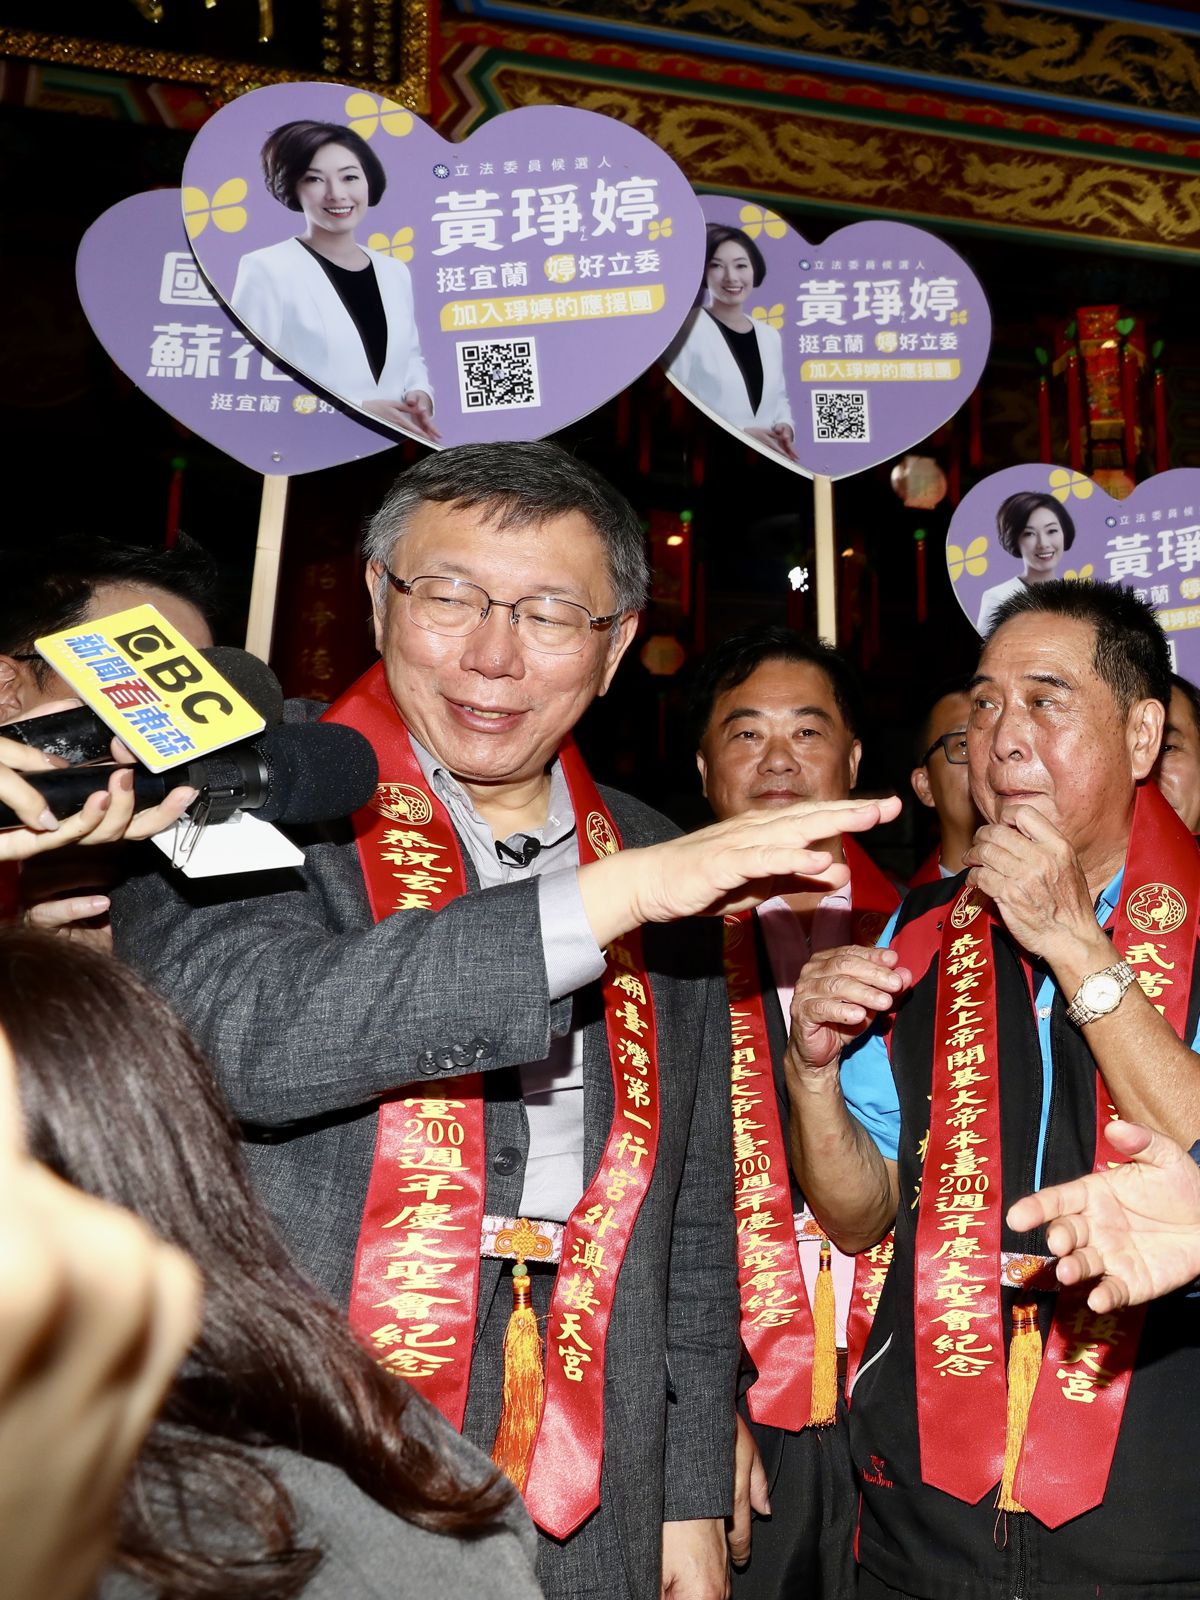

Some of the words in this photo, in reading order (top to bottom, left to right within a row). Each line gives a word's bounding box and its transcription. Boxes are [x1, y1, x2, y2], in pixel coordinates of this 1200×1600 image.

[454, 156, 612, 177] 立法委員候選人
[431, 175, 659, 256] 黃琤婷
[436, 261, 528, 293] 挺宜蘭
[547, 249, 660, 282] 婷好立委
[814, 260, 926, 271] 立法委員候選人
[452, 289, 653, 327] 加入琤婷的應援團
[796, 276, 959, 327] 黃琤婷
[799, 334, 864, 354] 挺宜蘭
[876, 332, 959, 352] 婷好立委
[210, 392, 281, 414] 挺宜蘭
[64, 632, 197, 758] 新聞看東森
